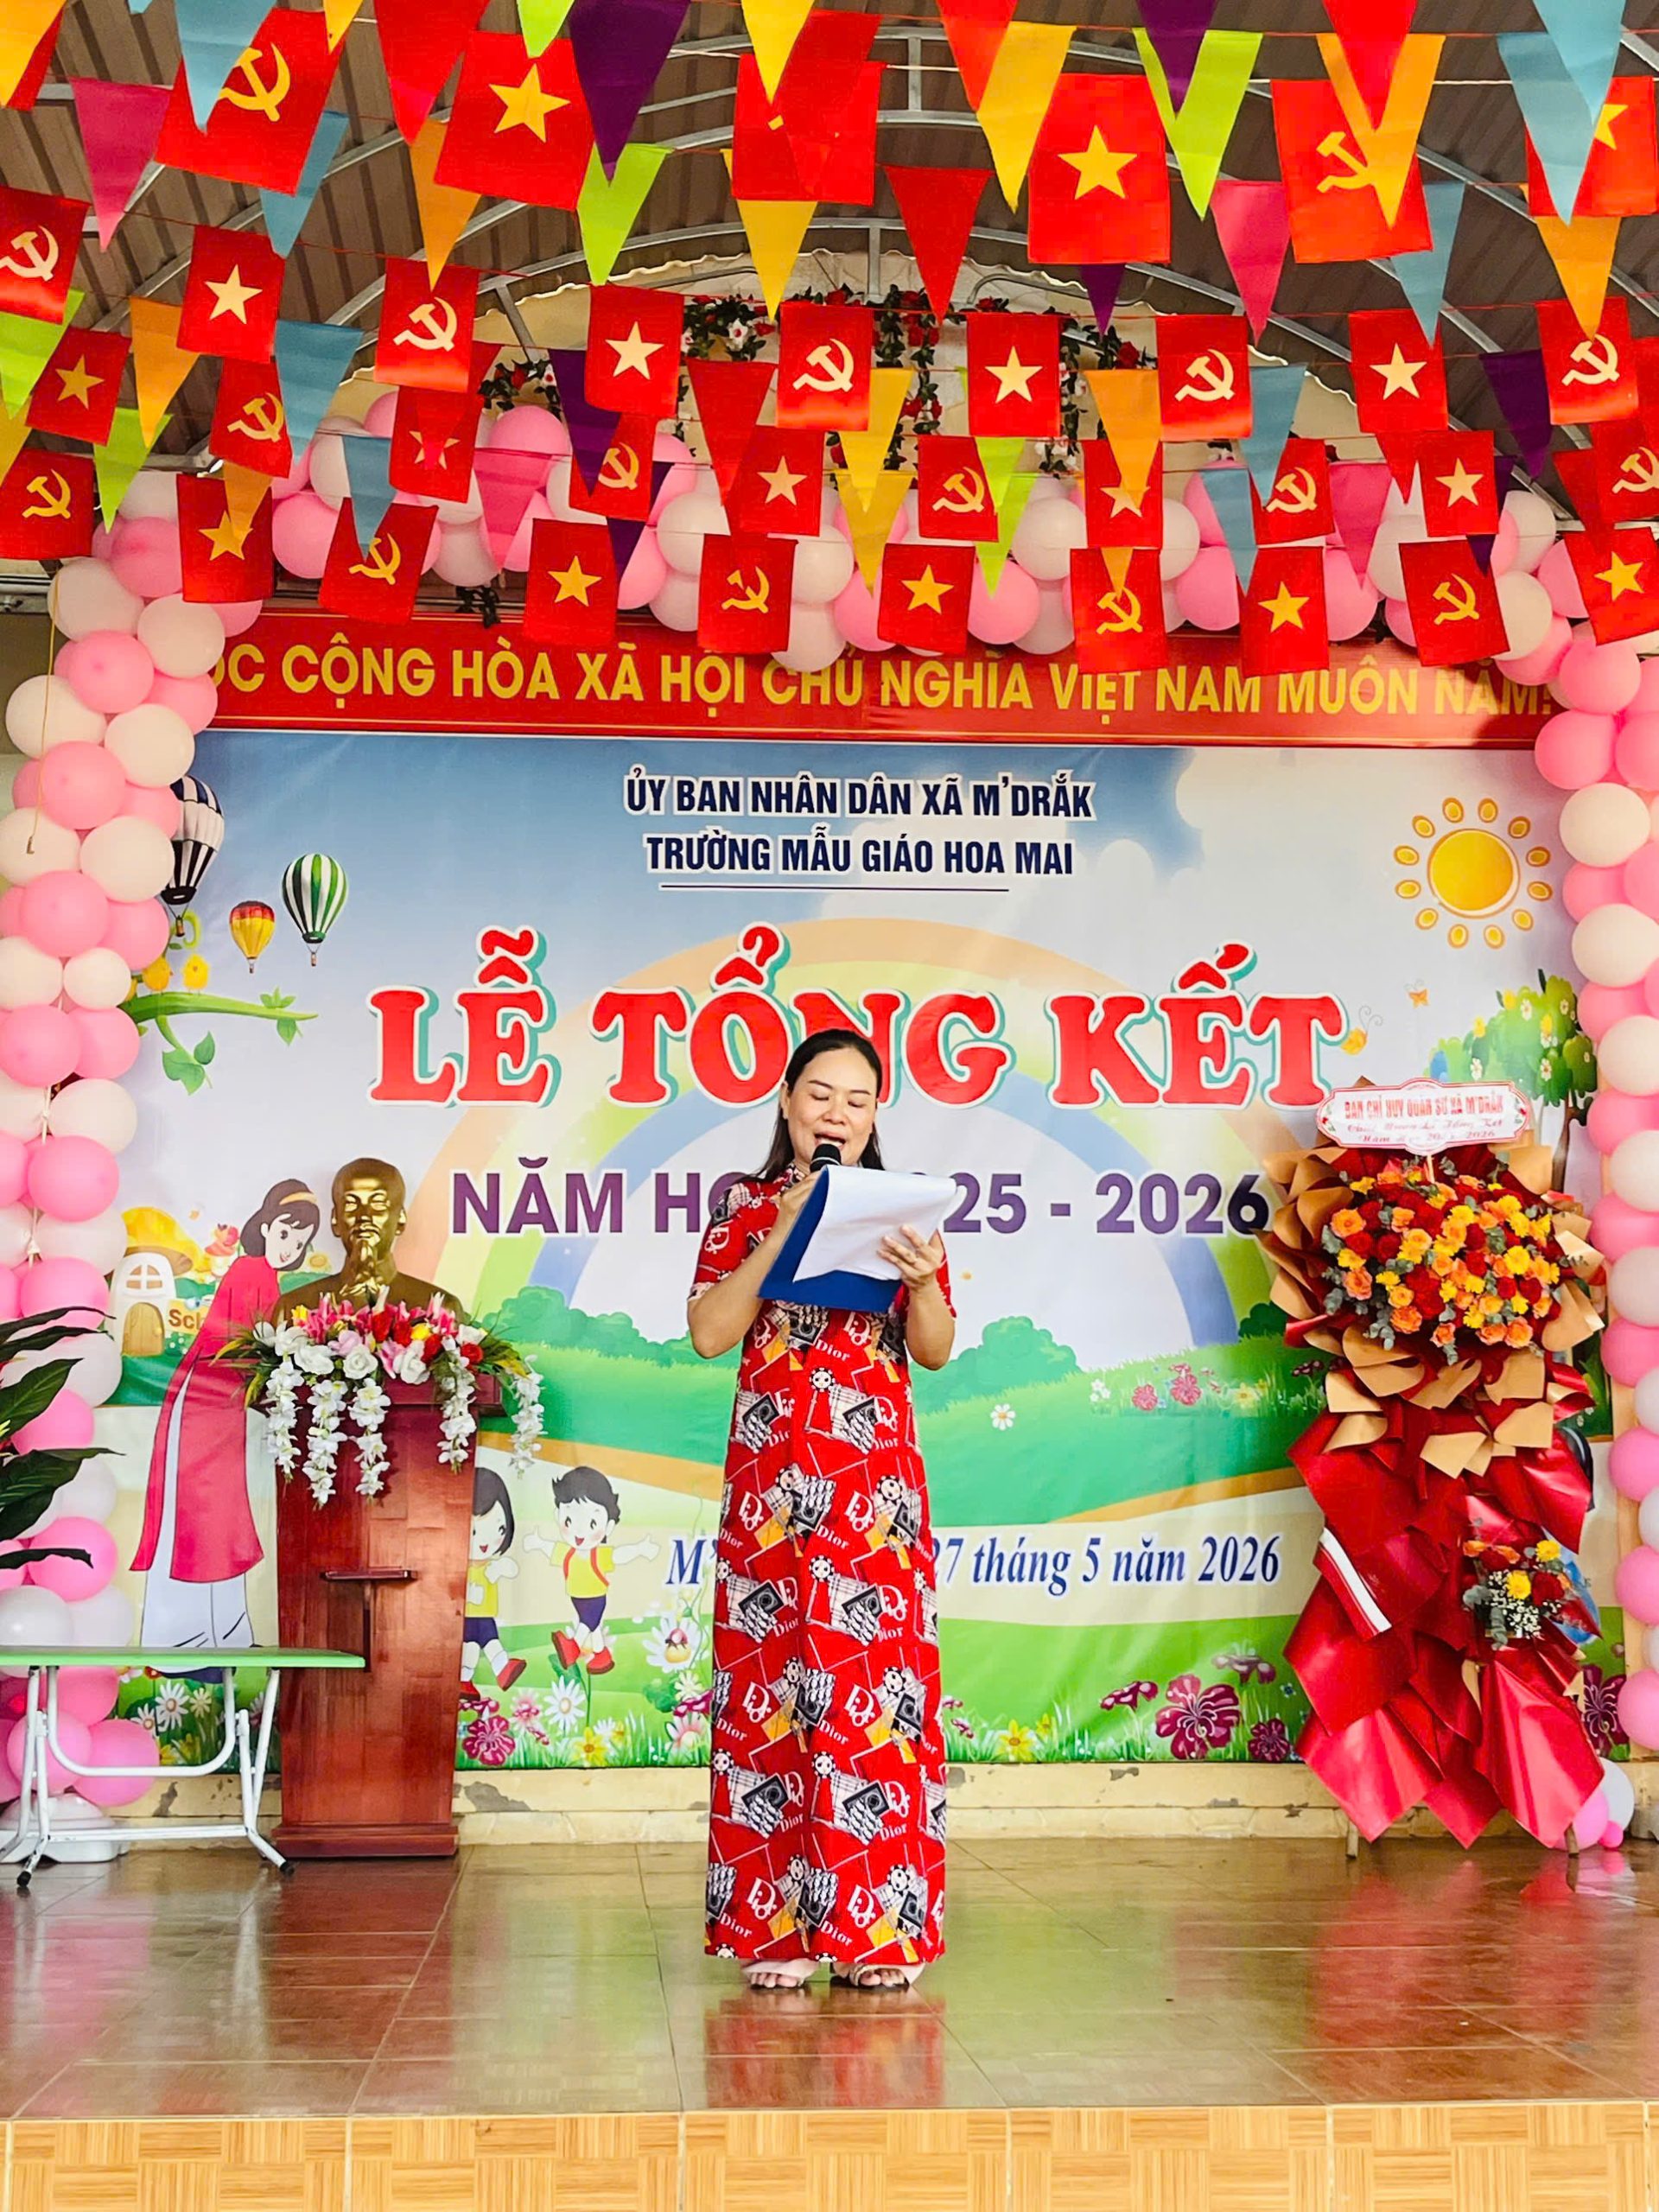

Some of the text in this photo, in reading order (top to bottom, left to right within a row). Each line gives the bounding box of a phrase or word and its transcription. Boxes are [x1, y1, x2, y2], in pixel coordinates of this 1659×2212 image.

[283, 632, 435, 709] CỘNG
[453, 636, 560, 699] HÒA
[575, 642, 644, 701] XÃ
[1155, 665, 1261, 713] NAM
[1278, 654, 1418, 715] MUÔN
[626, 767, 666, 812] ỦY
[677, 780, 740, 812] BAN
[751, 774, 838, 814] NHÂN
[849, 775, 912, 815] DÂN
[922, 777, 962, 816] XÃ
[646, 825, 1073, 874] TRƯỜNG MẪU GIÁO HOA MAI
[368, 924, 1344, 1108] LỄ TỔNG KẾT
[1344, 1101, 1363, 1119] BAN
[453, 1157, 560, 1234] NĂM
[944, 1173, 1027, 1234] 25
[1051, 1203, 1071, 1216] -
[1096, 1173, 1269, 1235] 2026
[816, 1339, 851, 1362] Dior
[720, 1528, 744, 1548] Dior
[817, 1524, 850, 1549] Dior
[973, 1535, 1071, 1596] tháng
[1082, 1538, 1102, 1582] 5
[1112, 1535, 1185, 1583] năm
[1198, 1535, 1281, 1582] 2026
[716, 1718, 748, 1742] Dior
[818, 1719, 849, 1745] Dior
[779, 1814, 804, 1833] Dior
[879, 1823, 908, 1841] Dior
[720, 1912, 753, 1939] Dior
[820, 1920, 854, 1947] Dior
